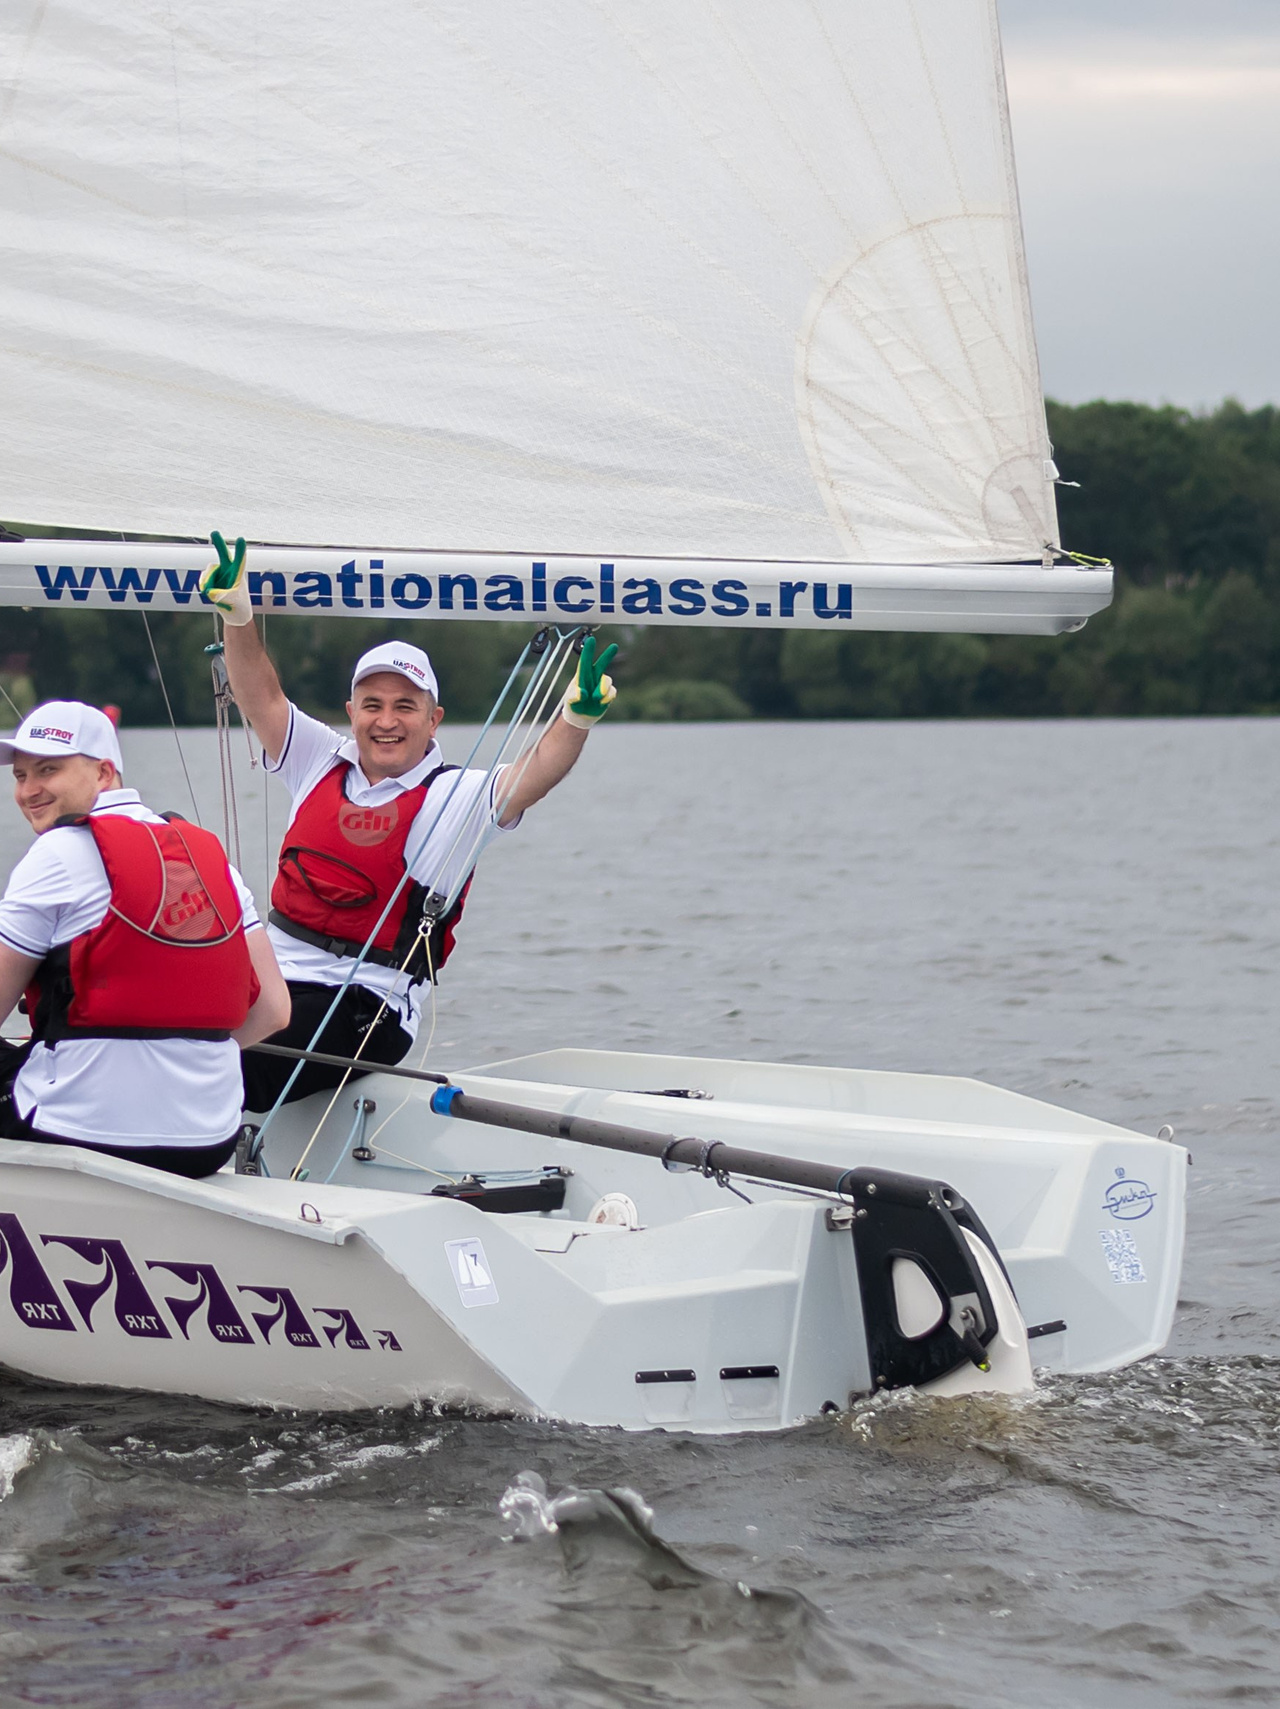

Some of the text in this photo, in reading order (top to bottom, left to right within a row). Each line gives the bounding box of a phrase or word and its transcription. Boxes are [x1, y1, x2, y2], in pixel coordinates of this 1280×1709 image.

[34, 559, 852, 620] wwwnationalclass.ru
[342, 810, 391, 831] Gill
[22, 1302, 61, 1320] ЯХТ
[125, 1314, 159, 1330] ЯХТ
[215, 1324, 245, 1338] ЯХТ
[290, 1332, 314, 1343] ЯХТ
